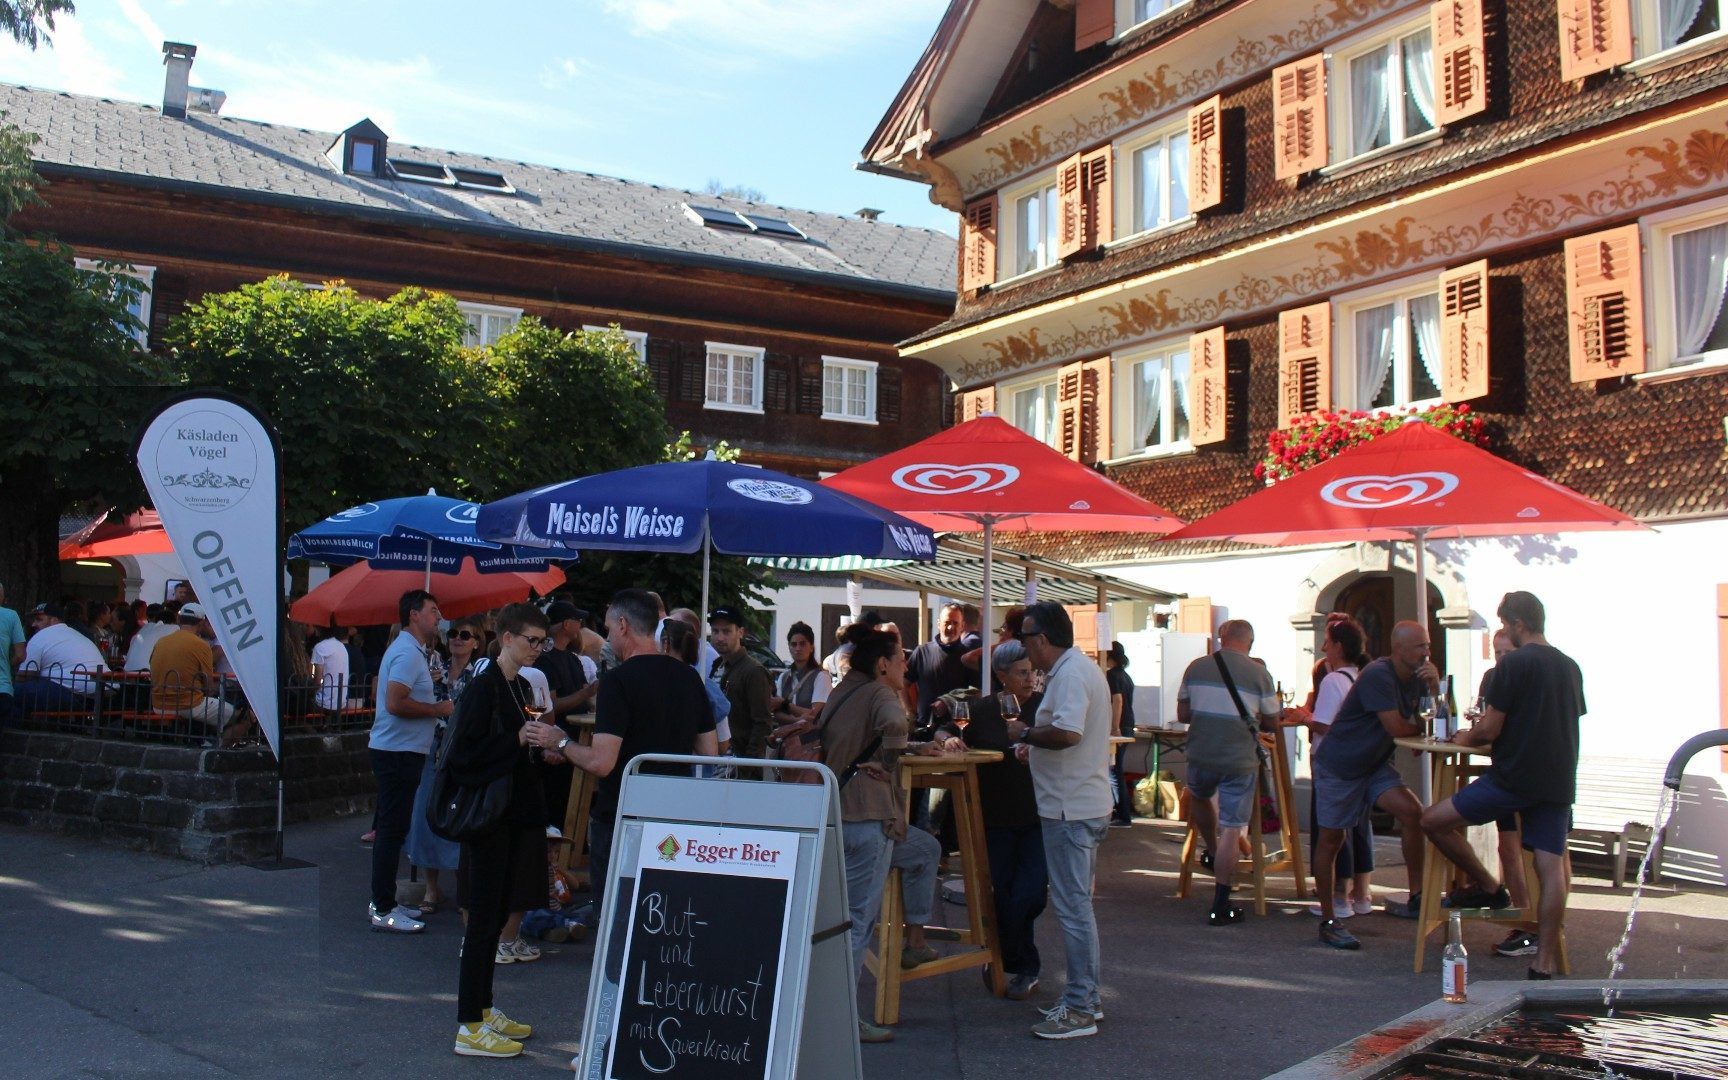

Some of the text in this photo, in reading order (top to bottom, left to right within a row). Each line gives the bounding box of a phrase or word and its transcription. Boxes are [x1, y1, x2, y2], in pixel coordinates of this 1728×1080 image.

[176, 429, 239, 442] Käsladen
[188, 446, 227, 461] Vögel
[546, 502, 620, 535] Maisel's
[623, 505, 685, 539] Weisse
[192, 530, 264, 652] OFFEN
[685, 839, 781, 864] Egger Bier
[641, 891, 709, 938] Blut-
[660, 940, 695, 968] und
[637, 960, 764, 1021] Leberwurst
[598, 992, 615, 1030] JOSEF
[629, 1013, 751, 1074] mit Sauerkraut
